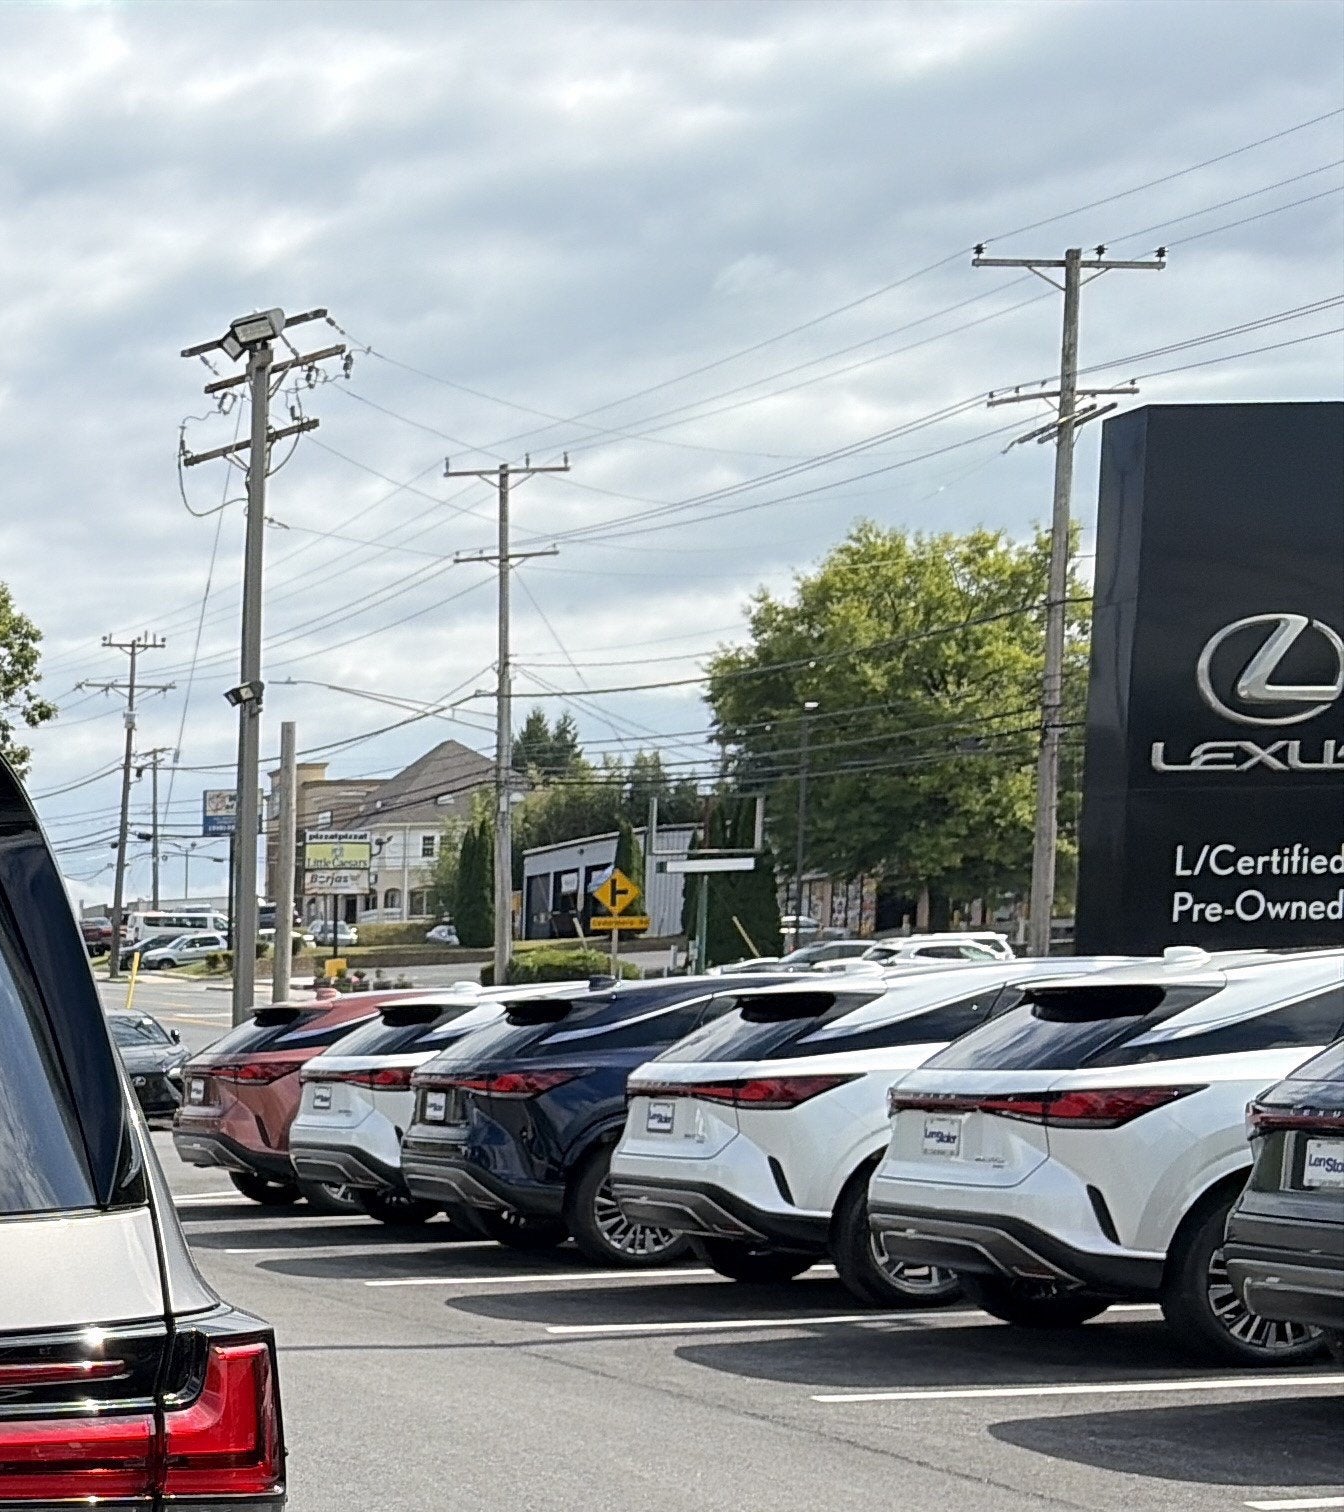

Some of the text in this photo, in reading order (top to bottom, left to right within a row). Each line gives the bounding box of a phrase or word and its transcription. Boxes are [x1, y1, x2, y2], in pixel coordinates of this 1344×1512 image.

[1152, 740, 1344, 771] LEXU
[1175, 844, 1344, 876] L/Certified
[1173, 889, 1344, 922] Pre-Owned
